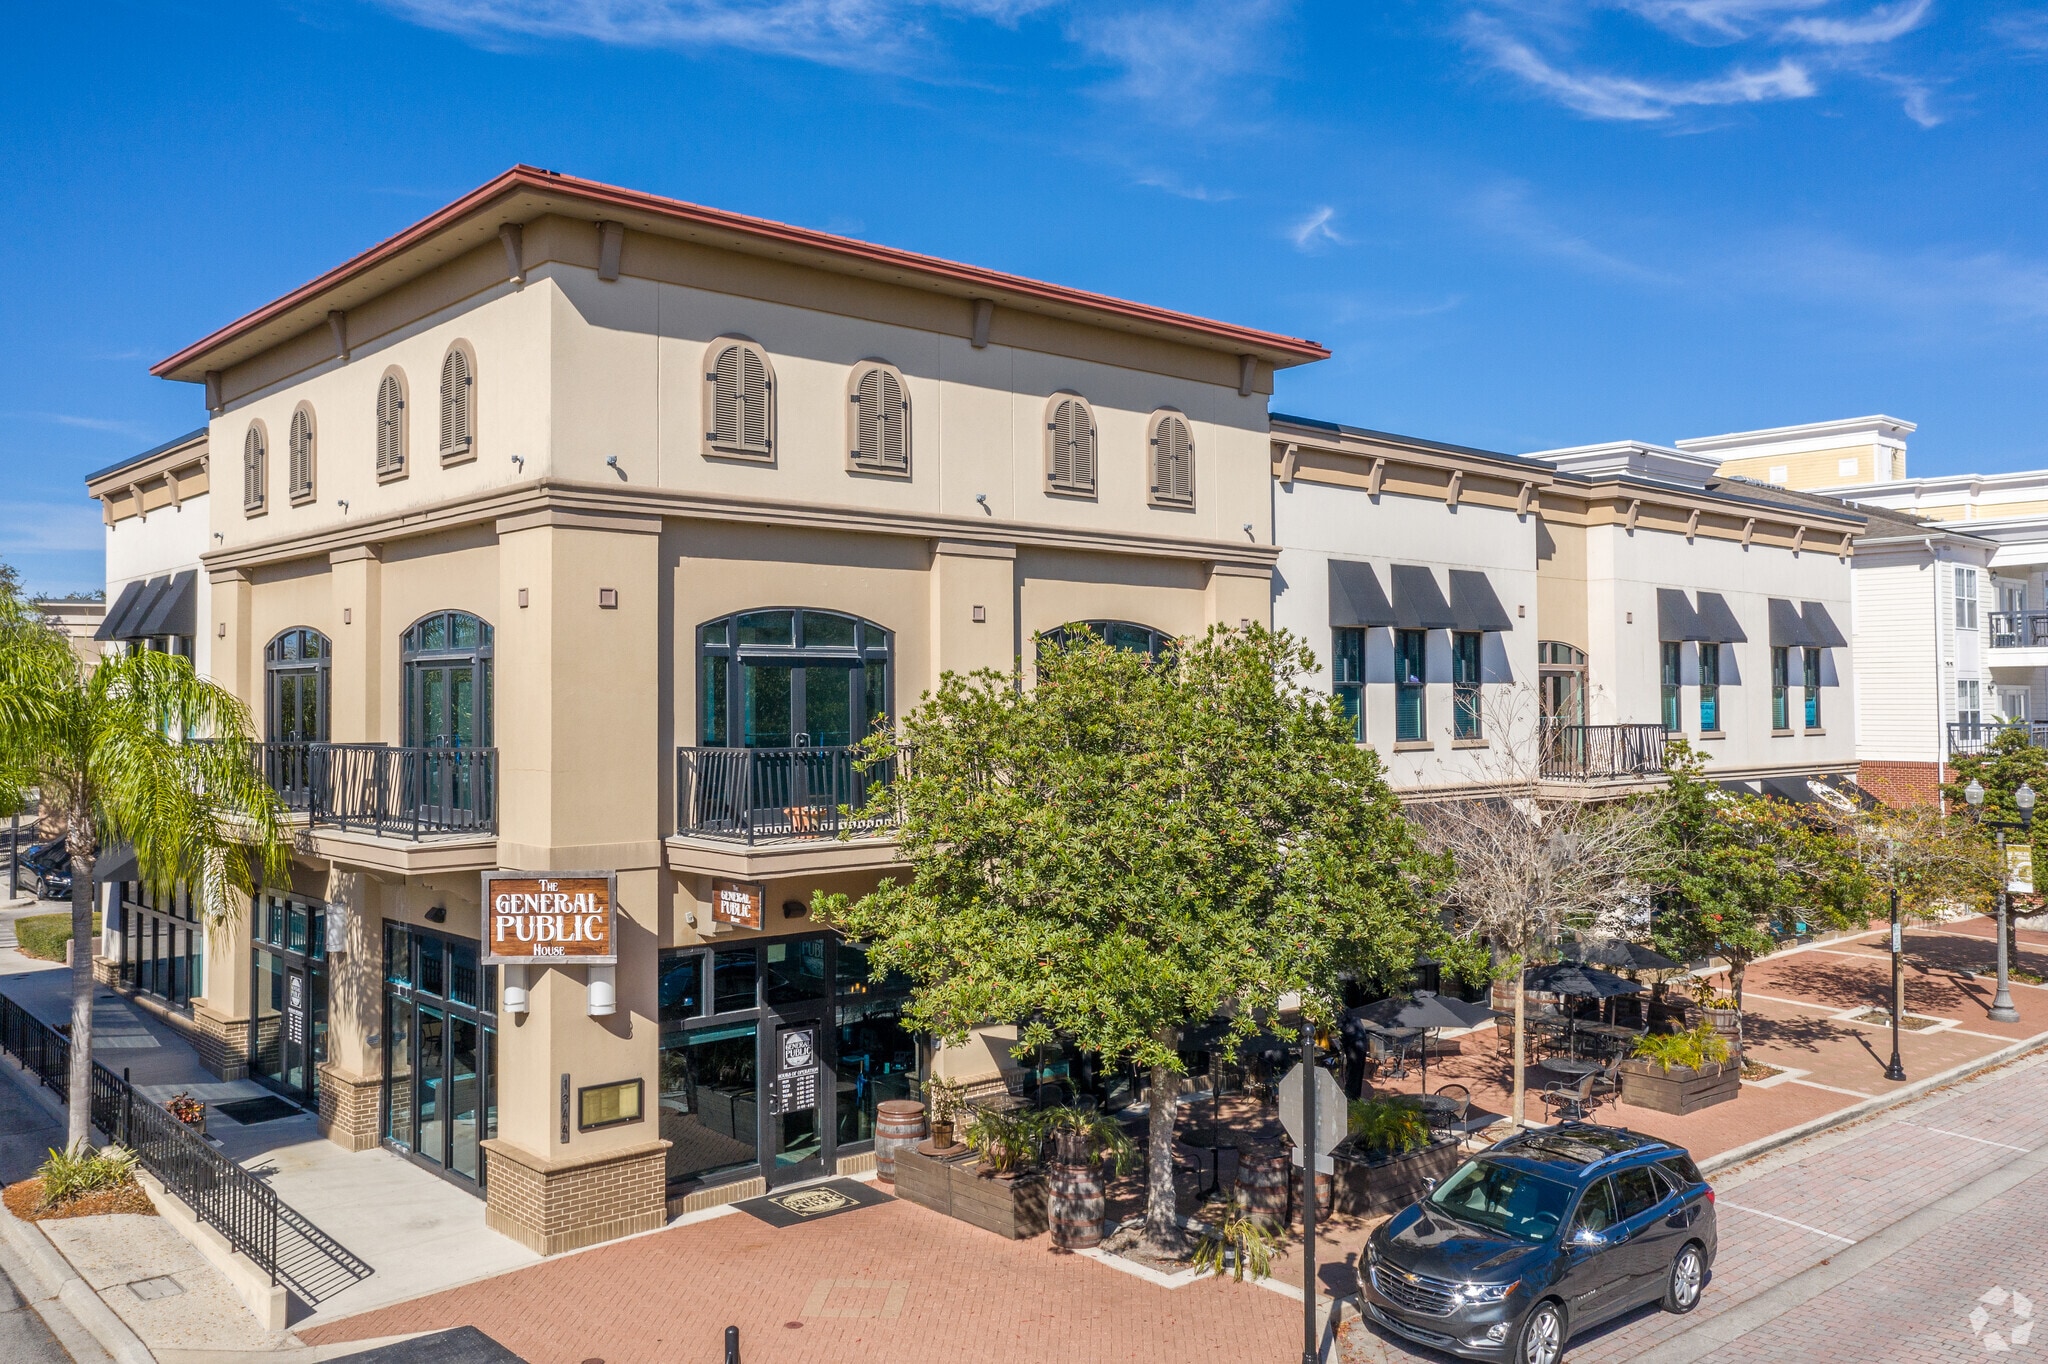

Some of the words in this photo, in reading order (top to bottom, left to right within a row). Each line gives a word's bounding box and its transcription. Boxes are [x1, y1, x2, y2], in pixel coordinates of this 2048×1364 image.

[496, 893, 604, 914] GENERAL
[721, 890, 751, 904] GENERAL
[720, 900, 751, 918] PUBLIC
[496, 916, 604, 942] PUBLIC
[786, 1047, 812, 1058] PUBLIC
